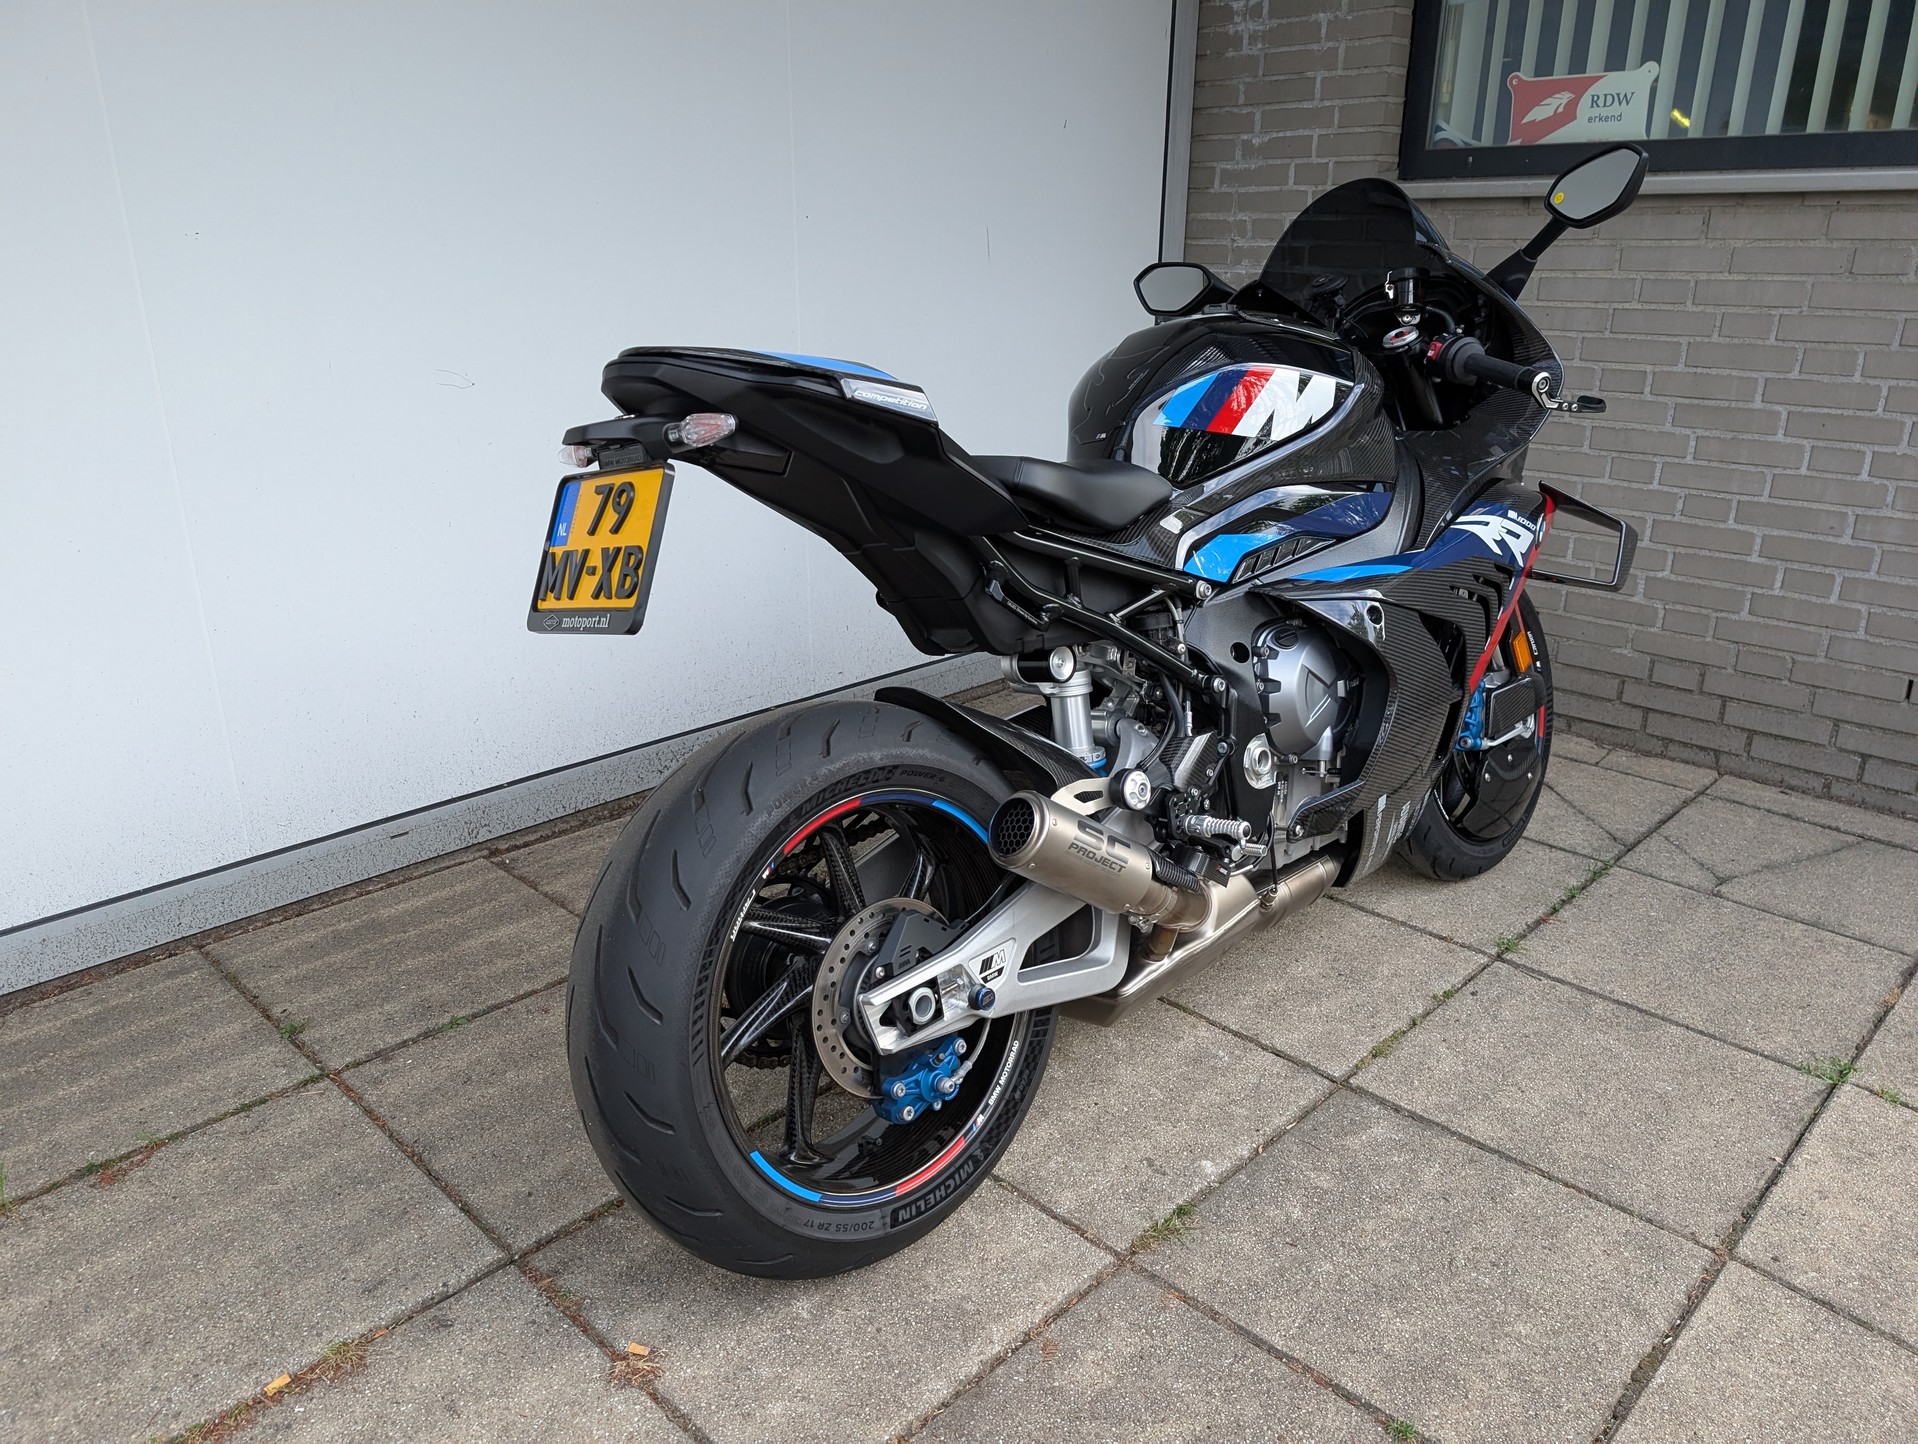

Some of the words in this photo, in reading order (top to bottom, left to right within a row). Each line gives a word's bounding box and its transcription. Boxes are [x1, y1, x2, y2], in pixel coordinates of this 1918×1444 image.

[1589, 91, 1636, 109] RDW
[1587, 111, 1623, 124] erkend
[854, 389, 928, 411] competition
[586, 481, 636, 536] 79
[557, 522, 567, 537] NL
[538, 545, 645, 601] MV-XB
[561, 614, 610, 630] motoport.nl
[802, 767, 891, 815] MICHELIN
[900, 769, 939, 781] POWER
[1073, 819, 1131, 866] SC
[1067, 842, 1127, 874] PROJECT
[988, 1085, 1002, 1107] BMW
[1000, 1040, 1020, 1087] MOTORRAD
[898, 1159, 975, 1222] MICHELIN
[803, 1219, 815, 1229] 17
[817, 1221, 834, 1232] ZR
[835, 1220, 875, 1233] 200/55
